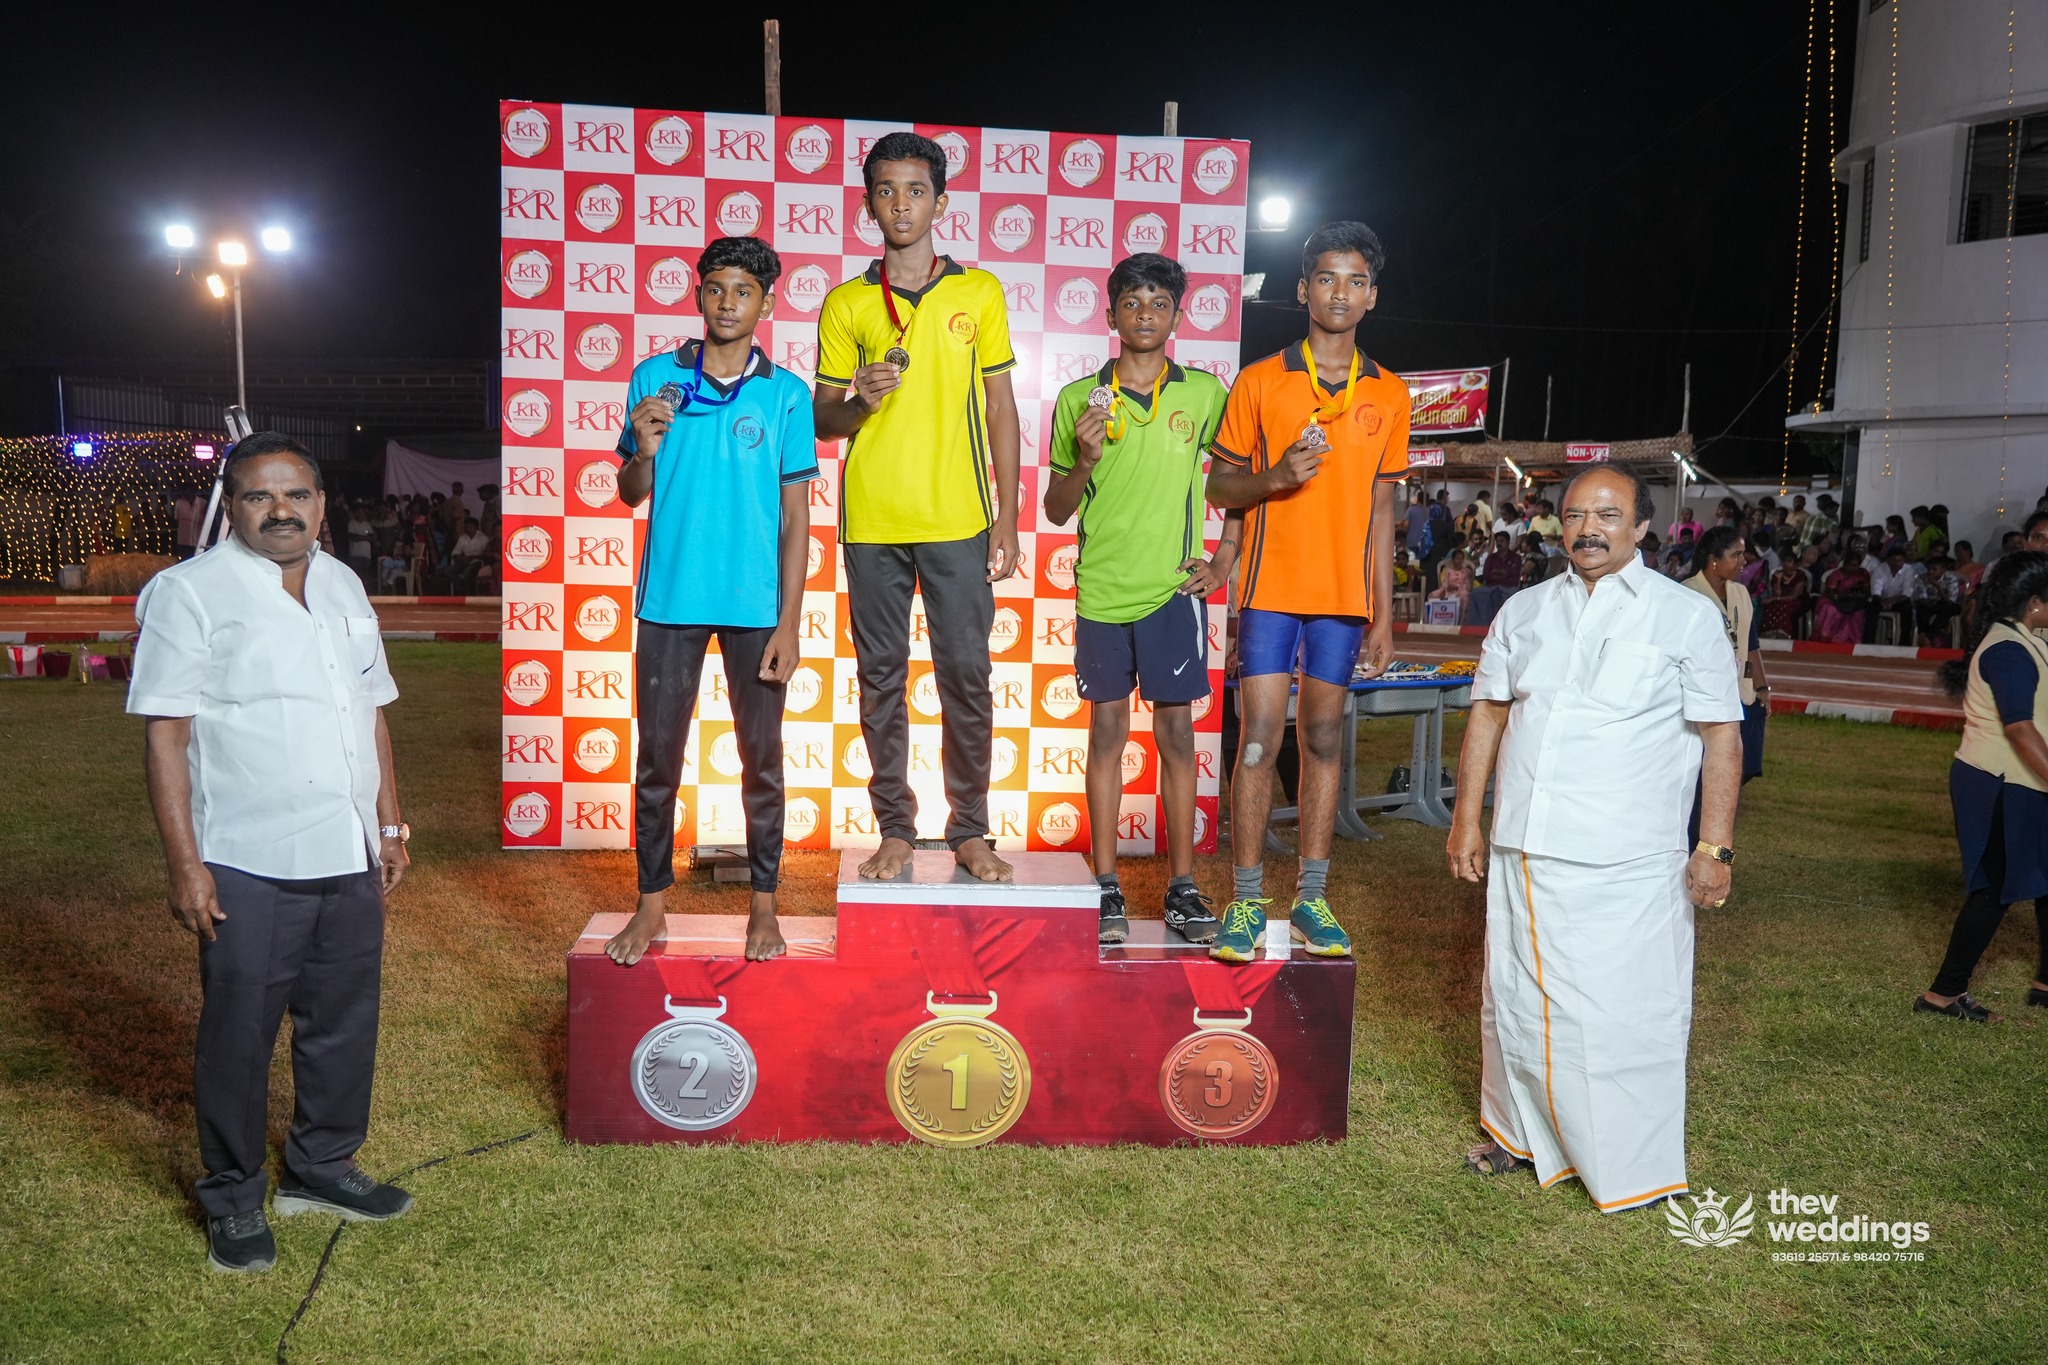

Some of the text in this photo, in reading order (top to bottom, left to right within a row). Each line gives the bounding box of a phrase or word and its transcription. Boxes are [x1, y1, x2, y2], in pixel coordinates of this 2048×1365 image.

[570, 122, 631, 154] RR
[710, 129, 770, 162] RR
[985, 144, 1043, 176] RR
[1120, 152, 1177, 183] RR
[502, 189, 560, 221] RR
[640, 196, 700, 228] RR
[778, 203, 838, 235] RR
[1050, 217, 1108, 248] RR
[1183, 224, 1240, 255] RR
[569, 262, 630, 294] RR
[502, 329, 560, 360] RR
[502, 466, 559, 497] RR
[568, 537, 628, 566] RR
[502, 602, 559, 631] RR
[568, 670, 627, 699] RR
[502, 734, 558, 764] RR
[1033, 746, 1089, 775] RR
[567, 801, 626, 830] RR
[678, 1052, 709, 1099] 2
[942, 1054, 969, 1110] 1
[1205, 1060, 1232, 1107] 3
